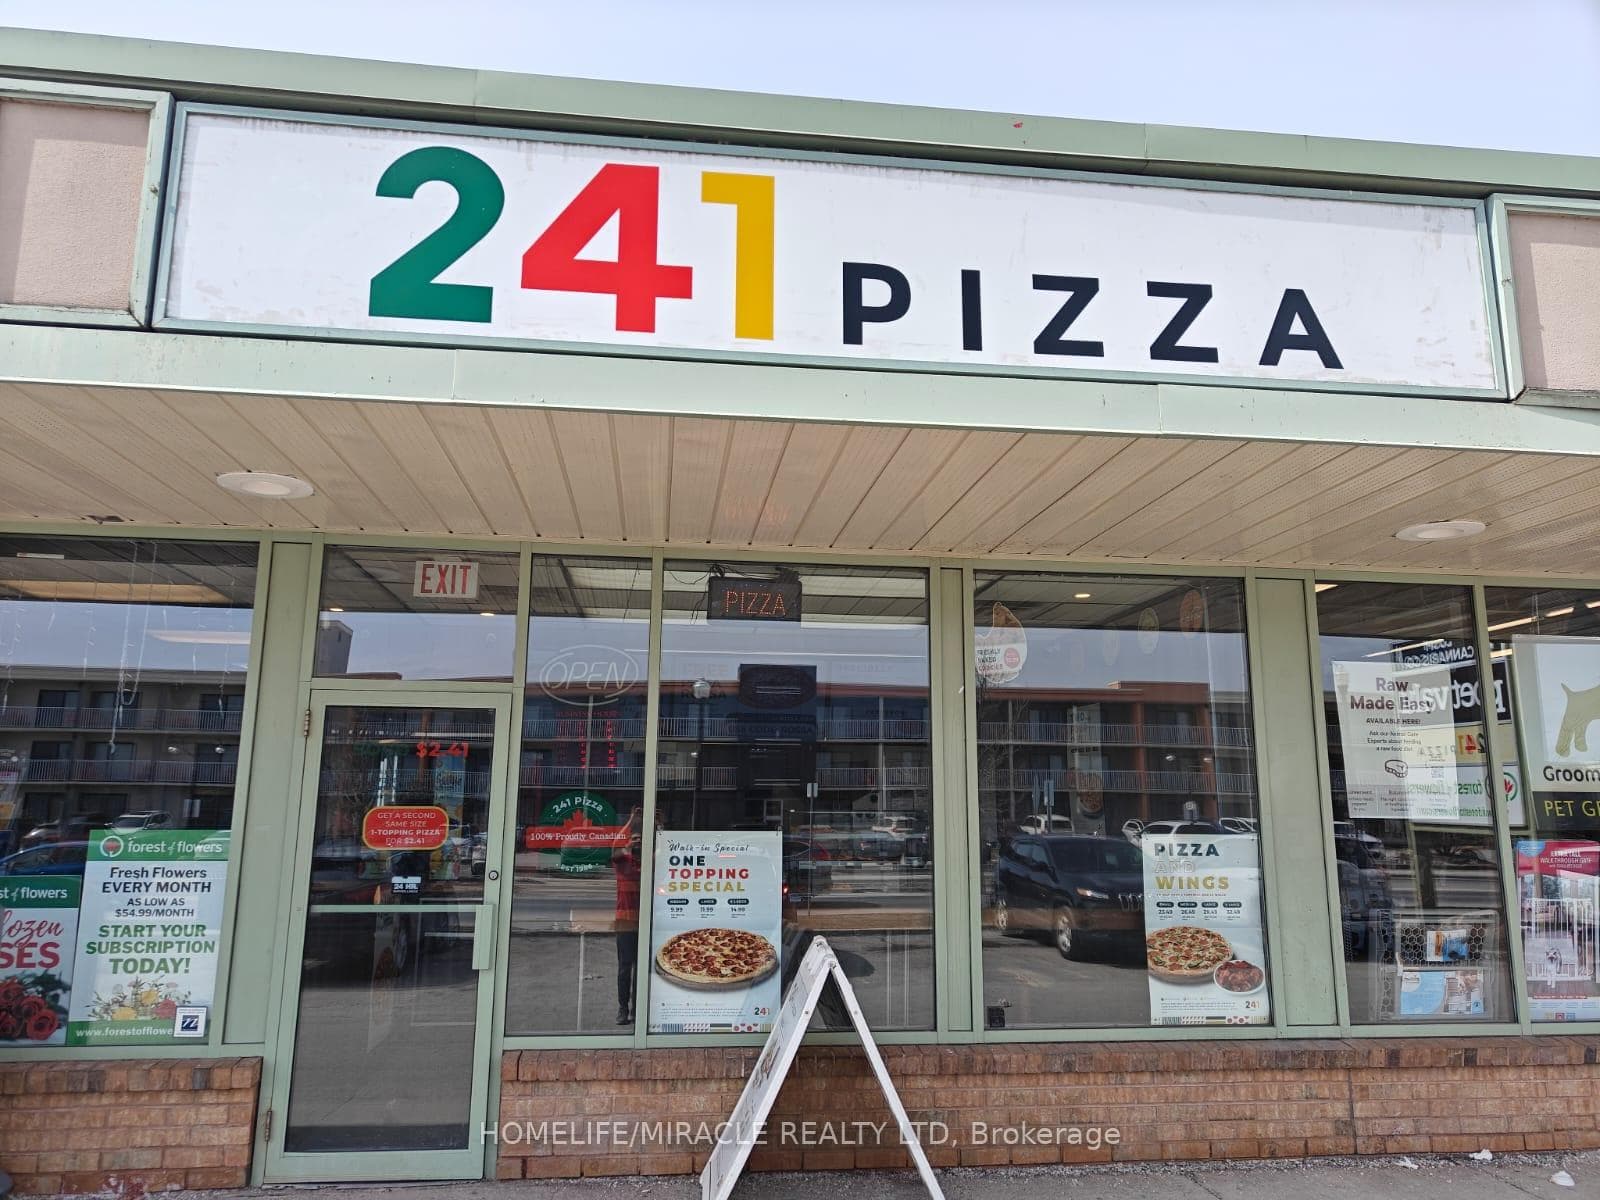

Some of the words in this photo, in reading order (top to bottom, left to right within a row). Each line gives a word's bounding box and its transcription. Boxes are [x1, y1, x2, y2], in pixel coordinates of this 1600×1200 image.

[368, 145, 775, 341] 241
[842, 261, 1345, 370] PIZZA
[419, 563, 472, 595] EXIT
[724, 588, 787, 618] PIZZA
[545, 661, 631, 690] OPEN
[1375, 677, 1409, 692] Raw
[1350, 695, 1395, 710] Made
[1399, 696, 1435, 714] Easy
[415, 741, 470, 758] $2.41
[552, 798, 572, 813] 241
[574, 796, 604, 812] Pizza
[1543, 800, 1575, 817] PET
[530, 832, 553, 841] 100%
[555, 832, 586, 841] Proudly
[588, 831, 626, 841] Canadian
[127, 840, 167, 853] forest
[177, 840, 223, 853] flowers
[668, 842, 711, 852] Walk-in
[713, 842, 750, 854] Special
[1154, 843, 1220, 857] PIZZA
[669, 855, 706, 867] ONE
[1154, 860, 1195, 874] AND
[110, 867, 149, 878] Fresh
[152, 867, 207, 878] Flowers
[668, 868, 750, 880] TOPPING
[101, 882, 151, 893] EVERY
[156, 882, 212, 893] MONTH
[668, 881, 746, 892] SPECIAL
[1155, 875, 1230, 890] WINGS
[21, 887, 68, 899] flowers
[127, 898, 142, 906] AS
[144, 898, 168, 906] LOW
[172, 898, 186, 906] AS
[115, 908, 194, 918] $54.99/MONTH
[98, 925, 157, 938] START
[160, 925, 207, 938] YOUR
[86, 940, 216, 955] SUBSCRIPTION
[109, 957, 191, 975] TODAY!
[1245, 1000, 1260, 1009] 241
[754, 1007, 770, 1016] 241
